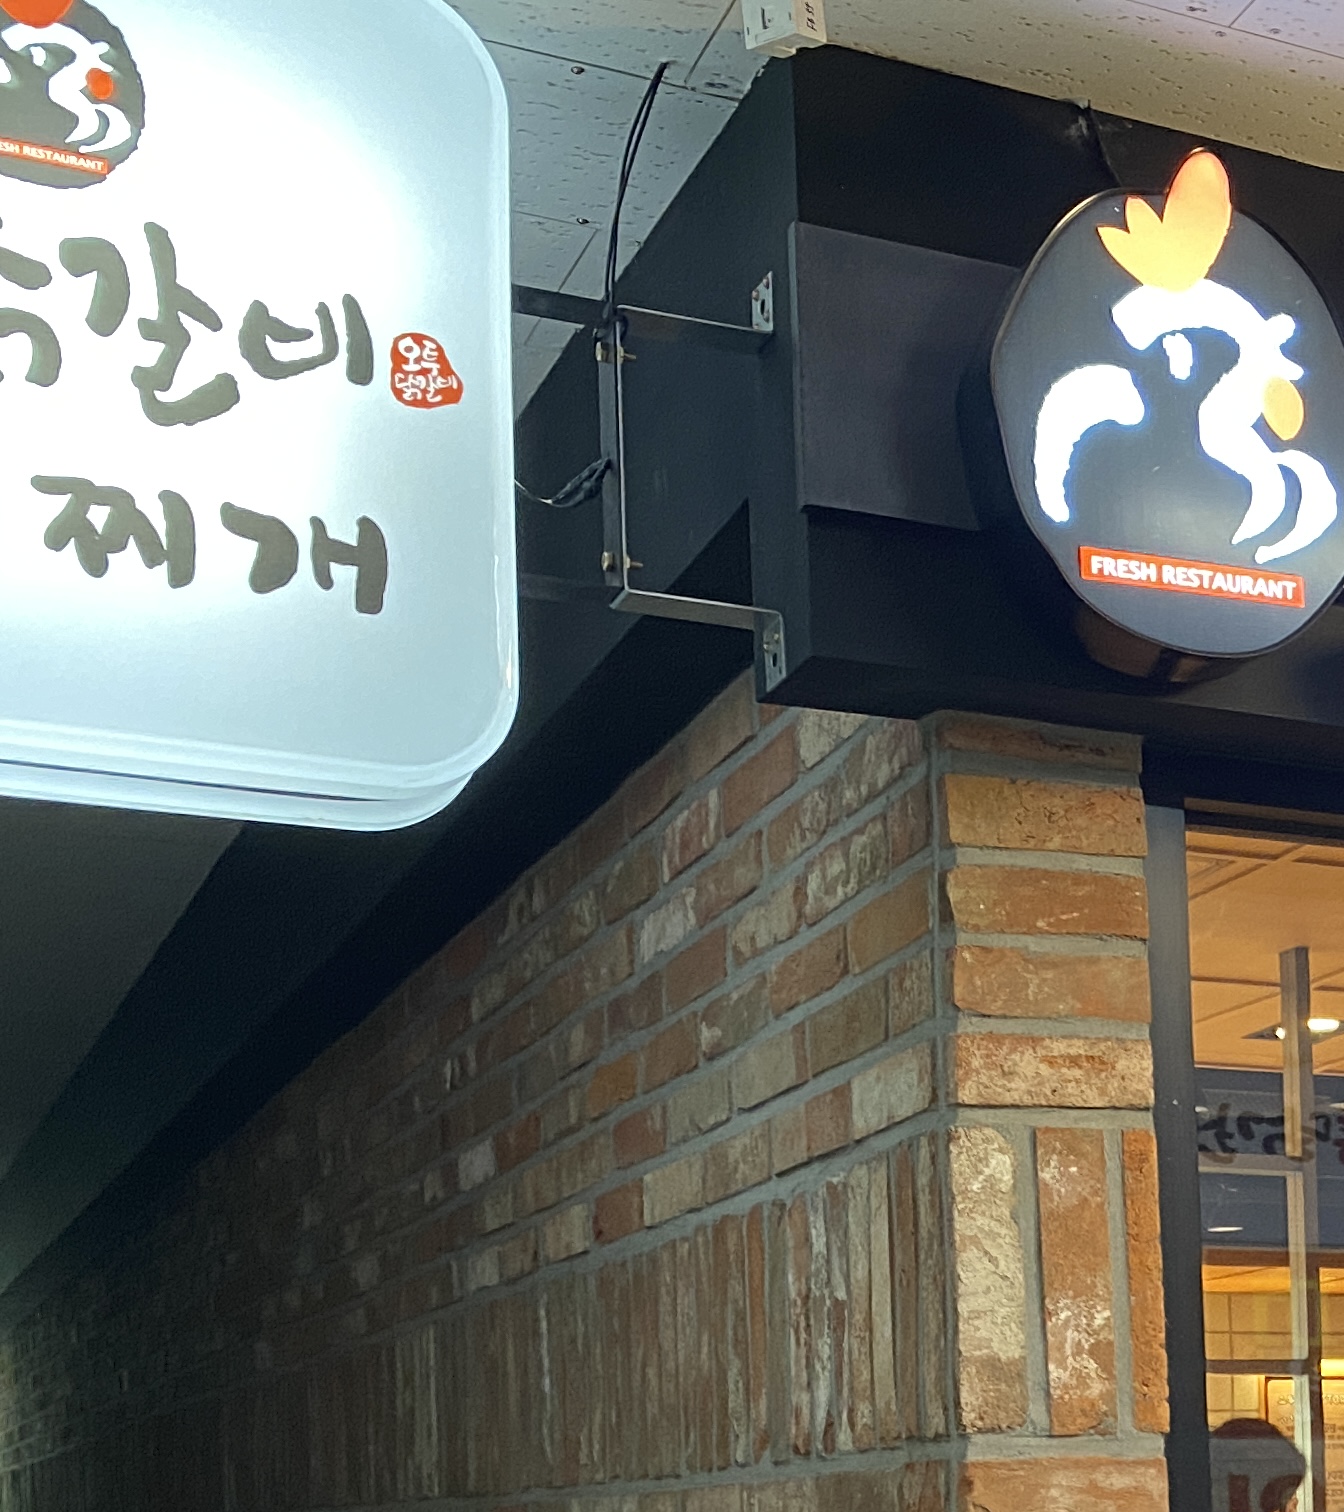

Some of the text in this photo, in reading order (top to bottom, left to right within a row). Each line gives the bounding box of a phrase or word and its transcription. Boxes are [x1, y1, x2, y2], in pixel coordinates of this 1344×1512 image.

[23, 145, 104, 170] RESTAURANT
[1090, 555, 1297, 600] FRESH RESTAURANT
